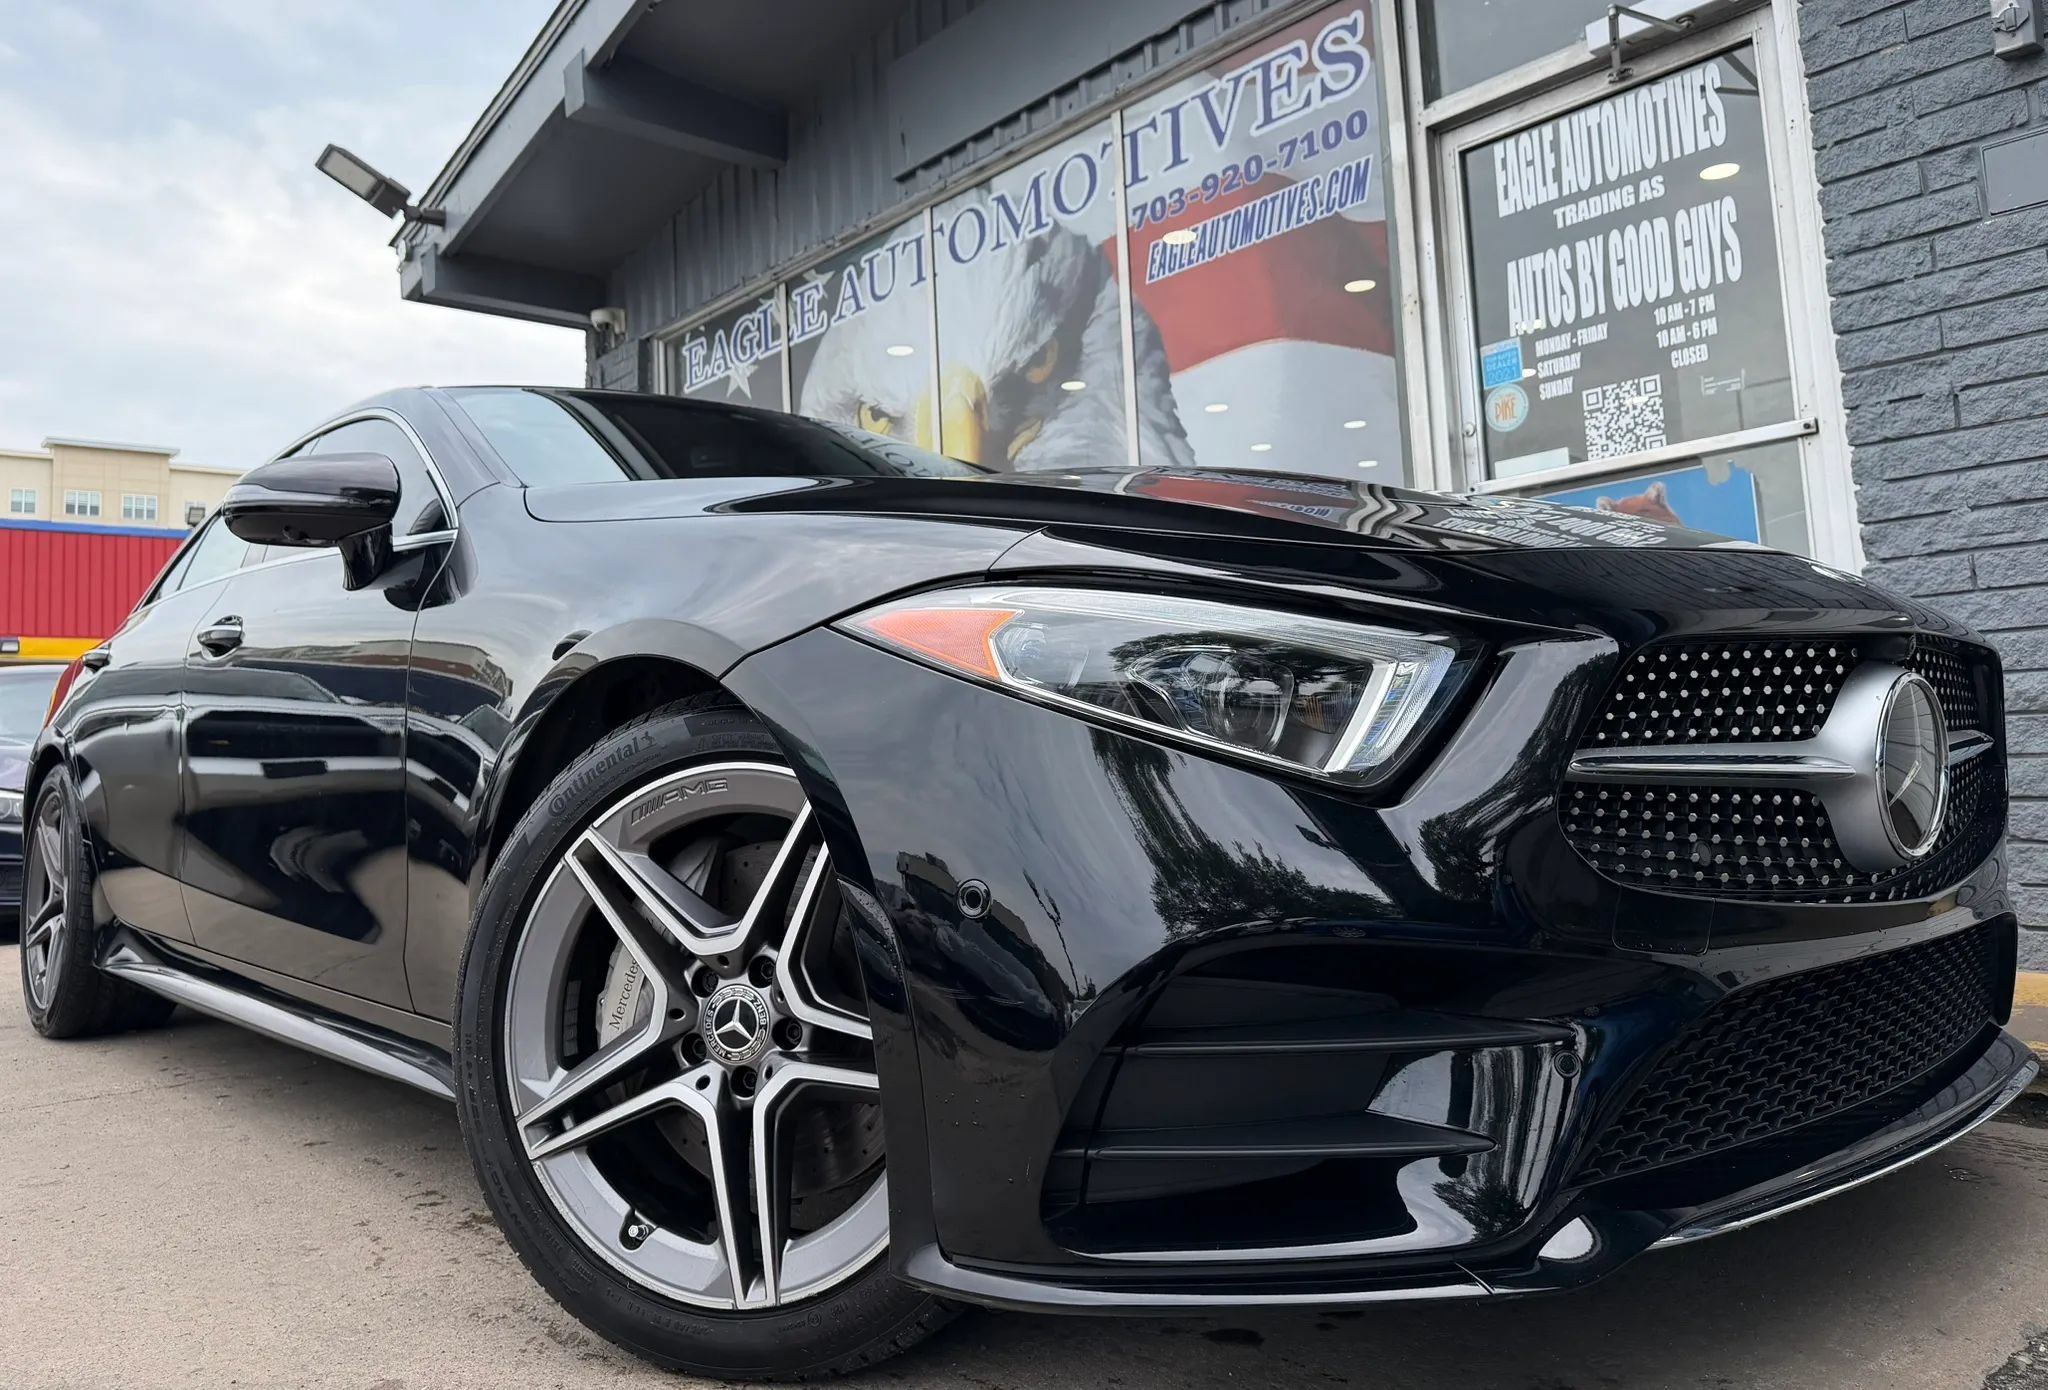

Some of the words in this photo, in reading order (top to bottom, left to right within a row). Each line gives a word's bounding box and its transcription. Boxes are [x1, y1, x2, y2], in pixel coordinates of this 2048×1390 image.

[1132, 109, 1368, 231] 703-920-7100
[1494, 124, 1558, 217] EAGLE
[1559, 63, 1727, 197] AUTOMOTIVES
[684, 284, 826, 391] EAGLE
[833, 14, 1368, 325] AUTOMOTIVES
[1147, 157, 1371, 282] EAGLEAUTOMOTIVES.COM
[1553, 185, 1635, 229] TRADING
[1639, 175, 1665, 202] AS
[1507, 244, 1576, 337] AUTOS
[1575, 234, 1606, 319] BY
[1608, 216, 1674, 311] GOOD
[1675, 195, 1742, 294] GUYS
[1535, 332, 1571, 357] MONDAY
[1577, 321, 1608, 346] FRIDAY
[1654, 306, 1667, 326] 10
[1667, 302, 1684, 323] AM
[1698, 293, 1715, 314] PM
[1537, 351, 1581, 378] SATURDAY
[1656, 329, 1669, 349] 10
[1670, 324, 1686, 346] AM
[1700, 316, 1718, 338] PM
[1539, 376, 1573, 401] SUNDAY
[1671, 343, 1709, 369] CLOSED
[549, 737, 640, 817] Continental
